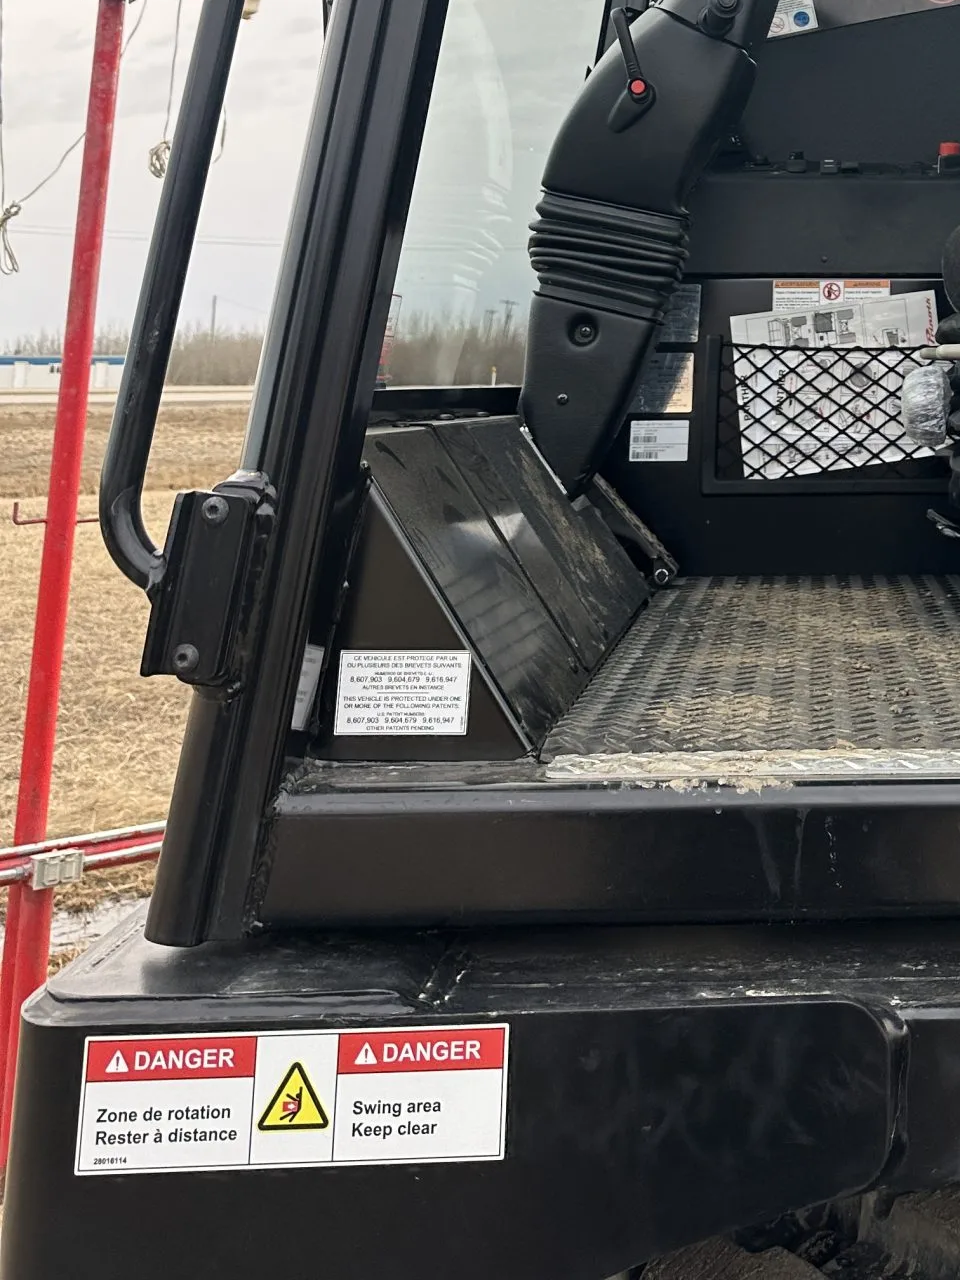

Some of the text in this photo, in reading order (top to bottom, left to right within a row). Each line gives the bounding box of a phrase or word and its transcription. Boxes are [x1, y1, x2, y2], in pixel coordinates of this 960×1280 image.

[133, 1048, 235, 1071] DANGER
[382, 1040, 481, 1063] DANGER
[96, 1105, 231, 1123] Zone de rotation
[352, 1100, 441, 1120] Swing area
[95, 1127, 238, 1146] Rester à distance
[351, 1121, 437, 1140] Keep clear
[94, 1157, 127, 1165] 28016114
